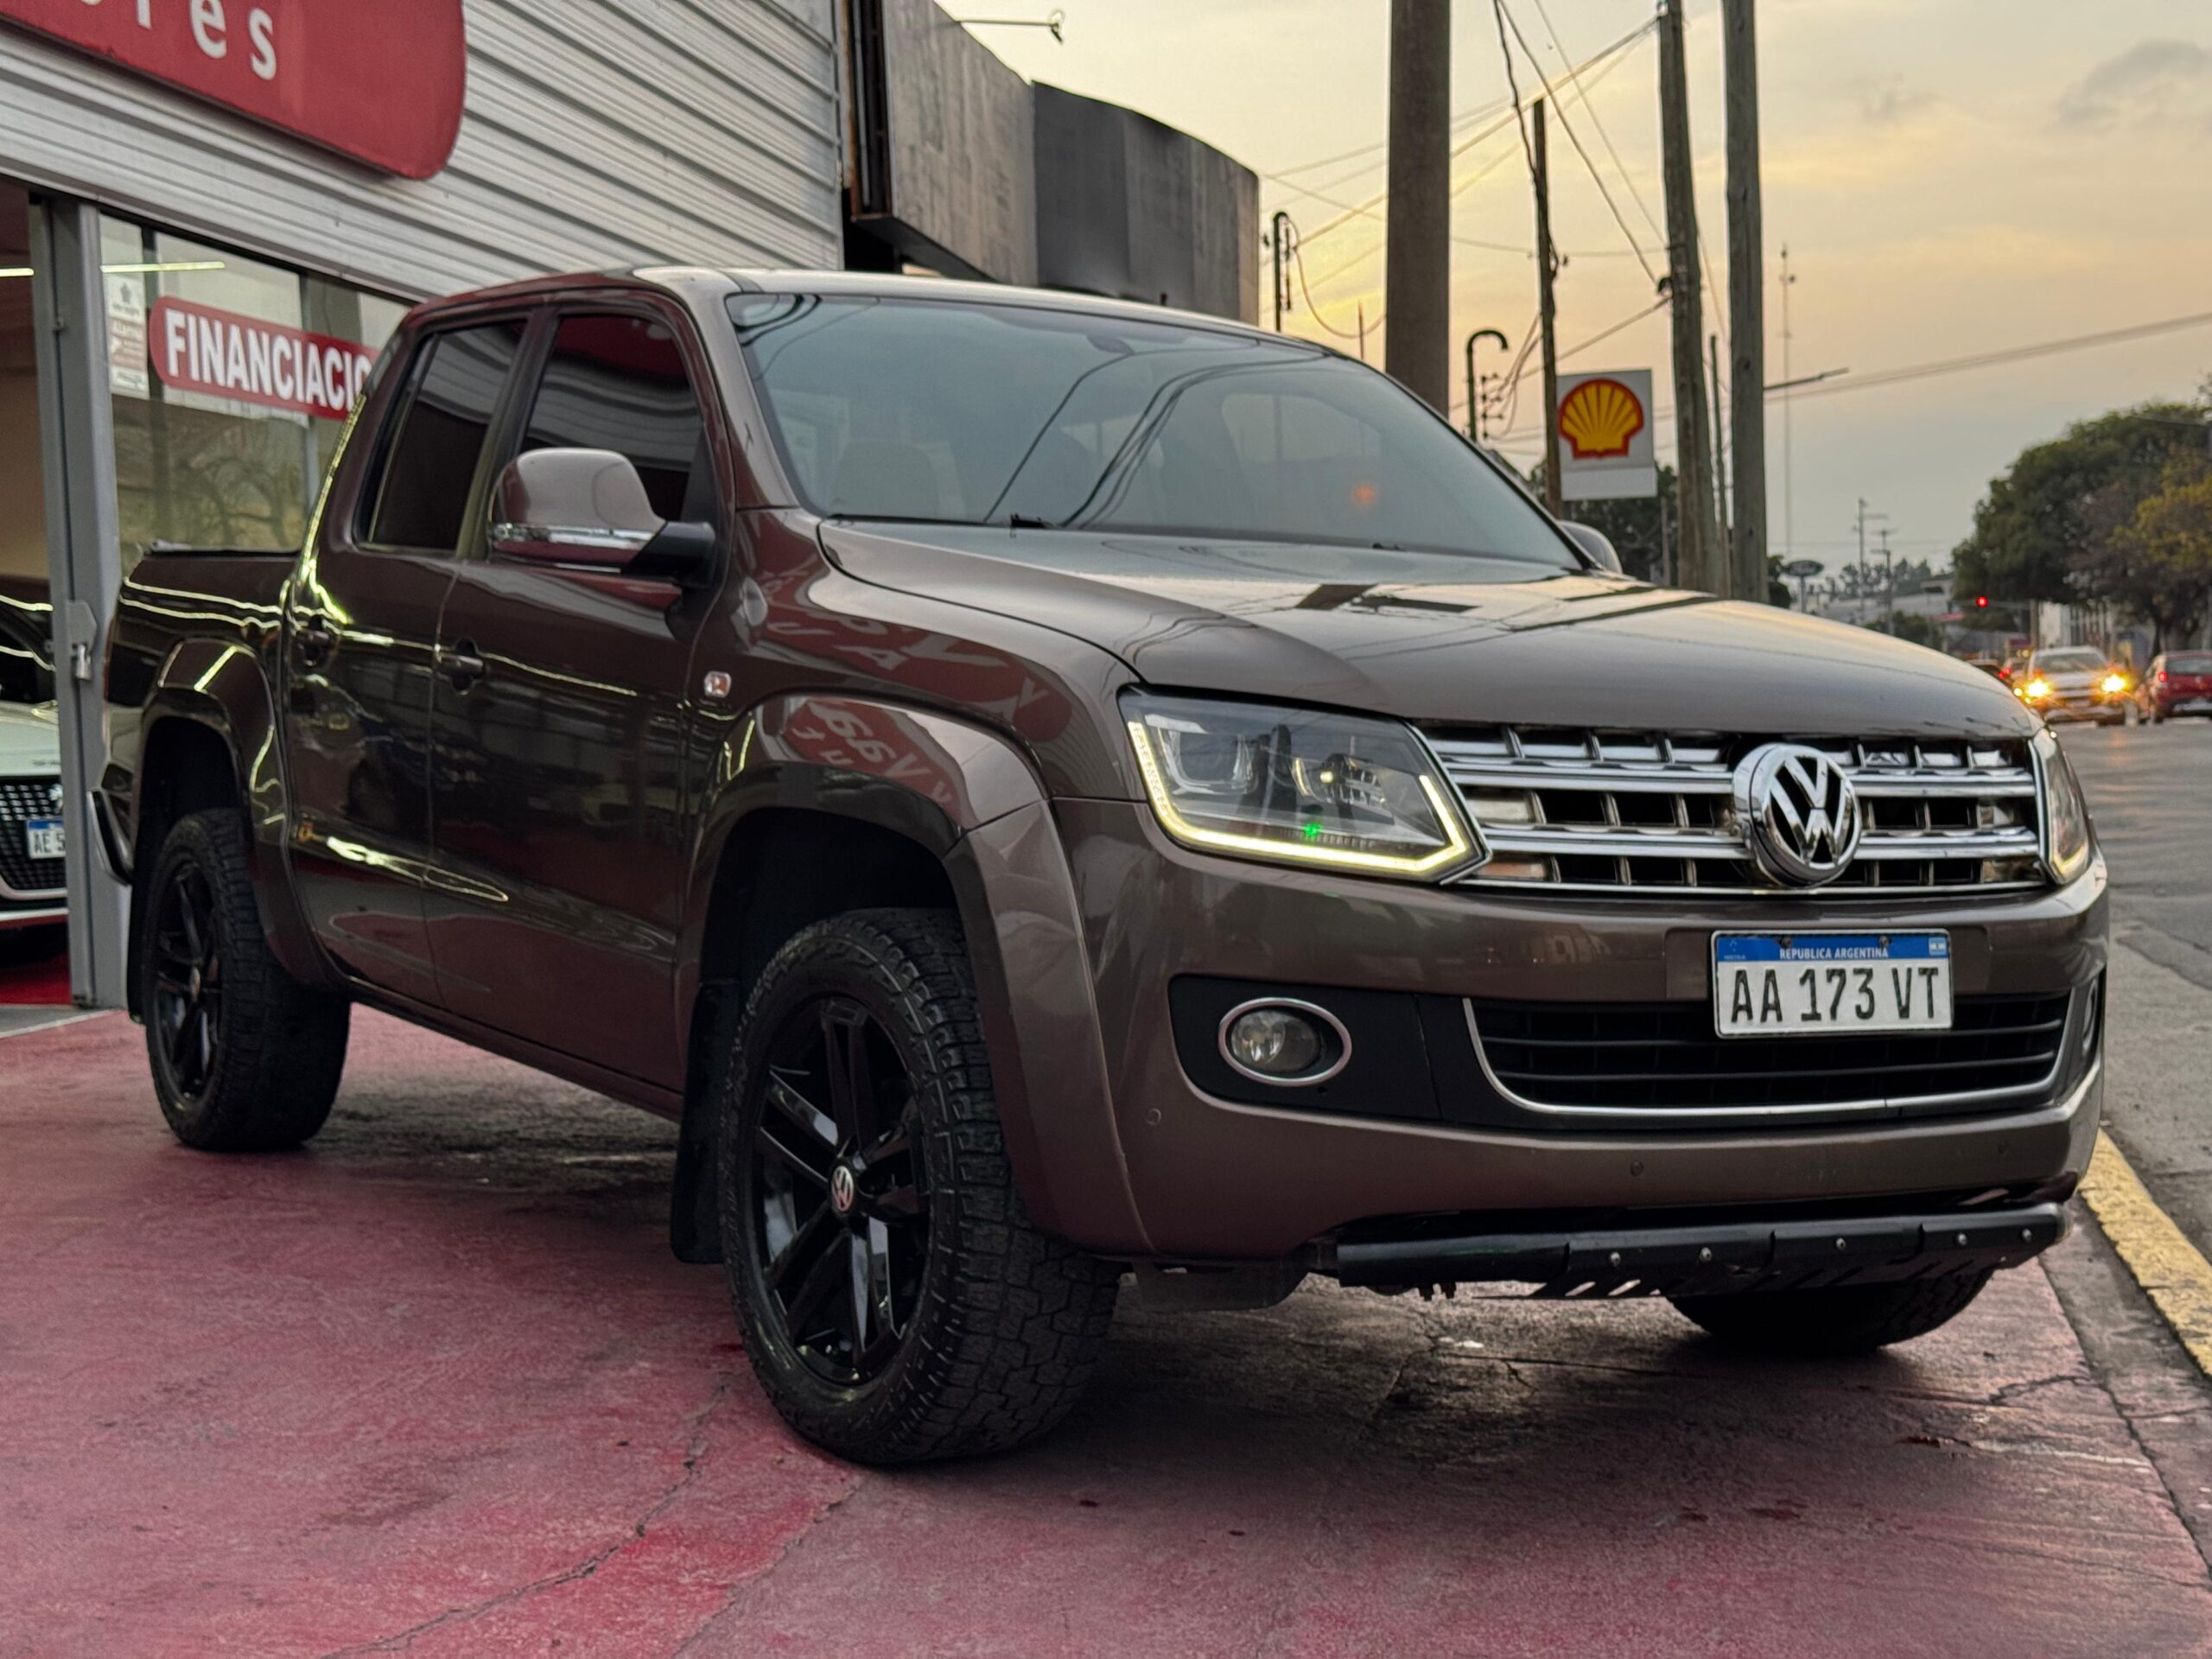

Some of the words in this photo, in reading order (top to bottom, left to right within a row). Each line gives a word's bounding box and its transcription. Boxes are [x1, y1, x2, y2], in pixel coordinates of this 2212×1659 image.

[1834, 947, 1889, 959] ARGENTINA
[1731, 969, 1783, 1022] AA
[1799, 968, 1876, 1021] 173
[1891, 966, 1939, 1020] VT
